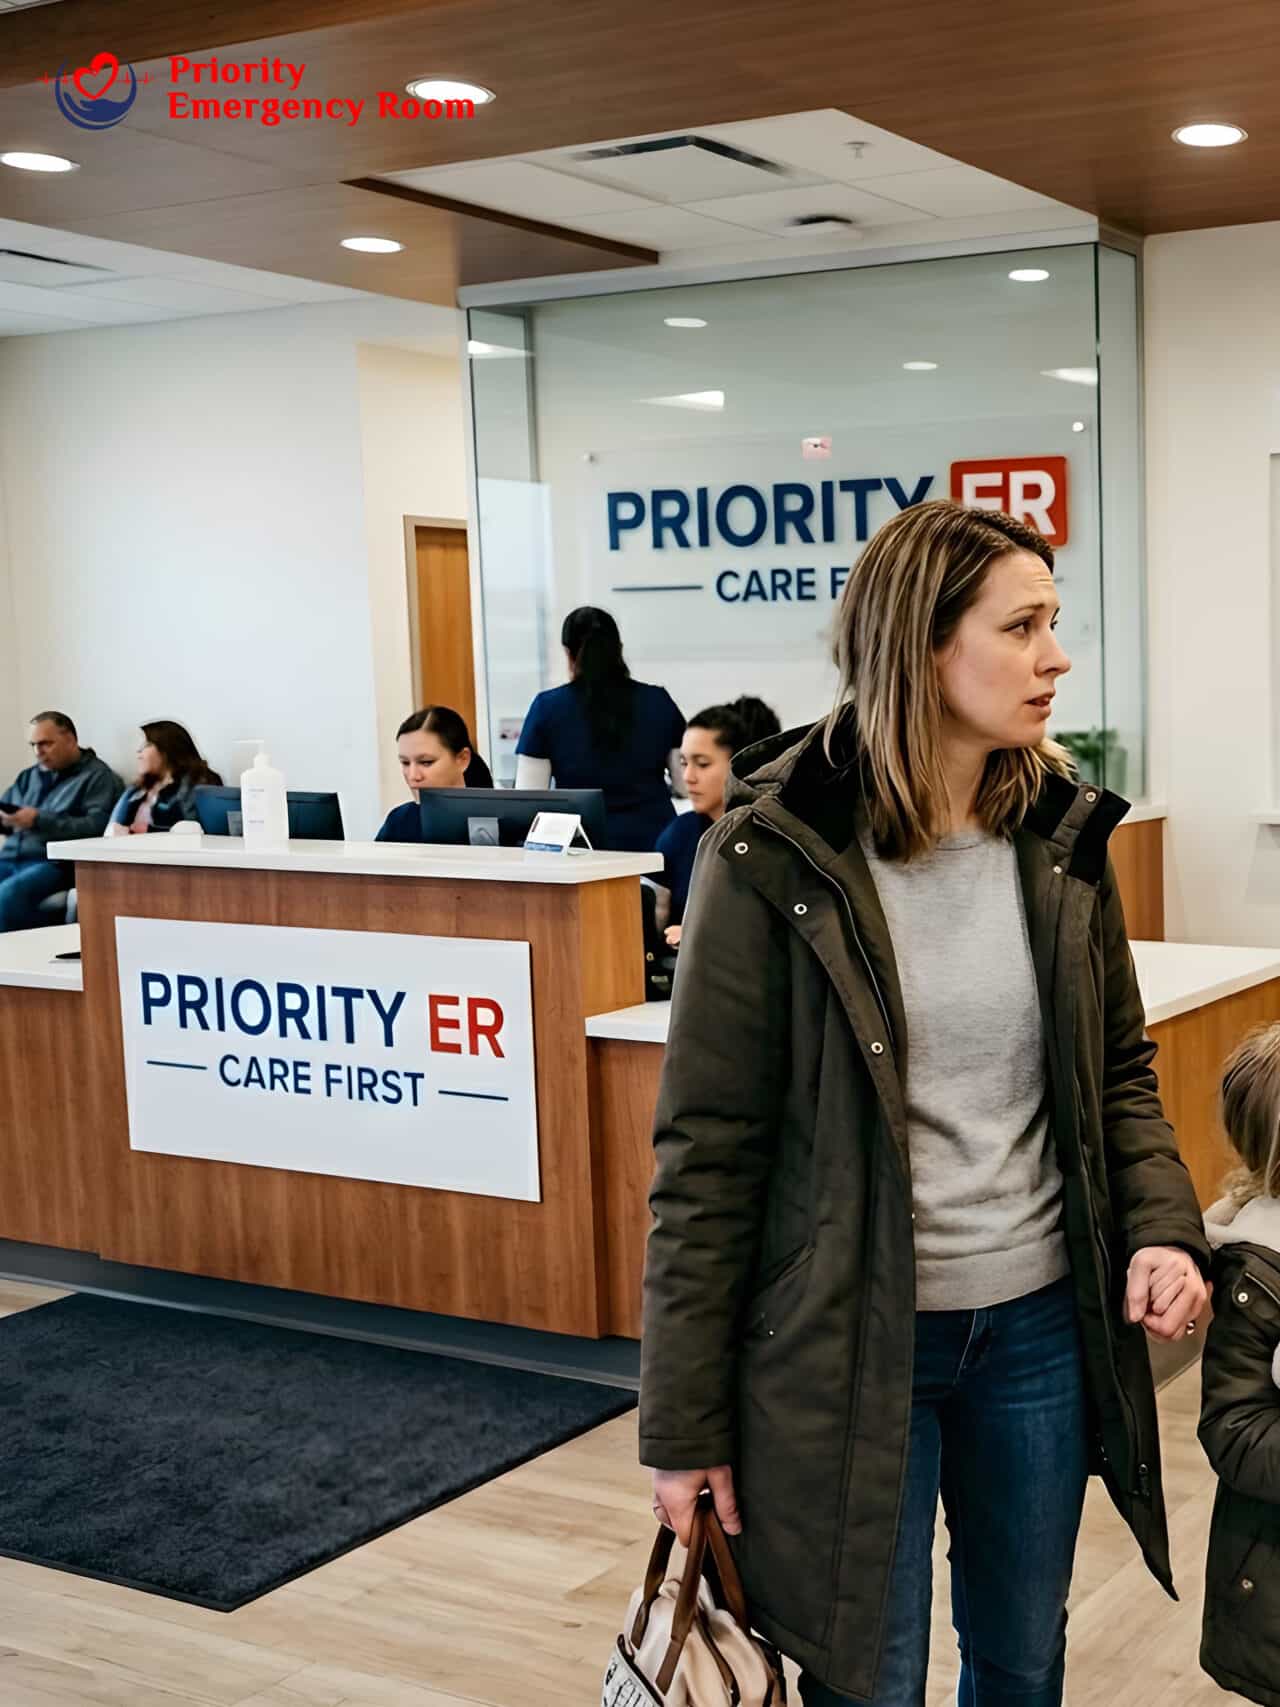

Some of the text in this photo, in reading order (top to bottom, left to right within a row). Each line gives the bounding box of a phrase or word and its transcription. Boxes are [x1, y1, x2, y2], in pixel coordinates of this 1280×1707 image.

[607, 475, 934, 551] PRIORITY
[716, 567, 816, 602] CARE
[141, 971, 505, 1058] PRIORITY ER
[218, 1053, 425, 1106] CARE FIRST
